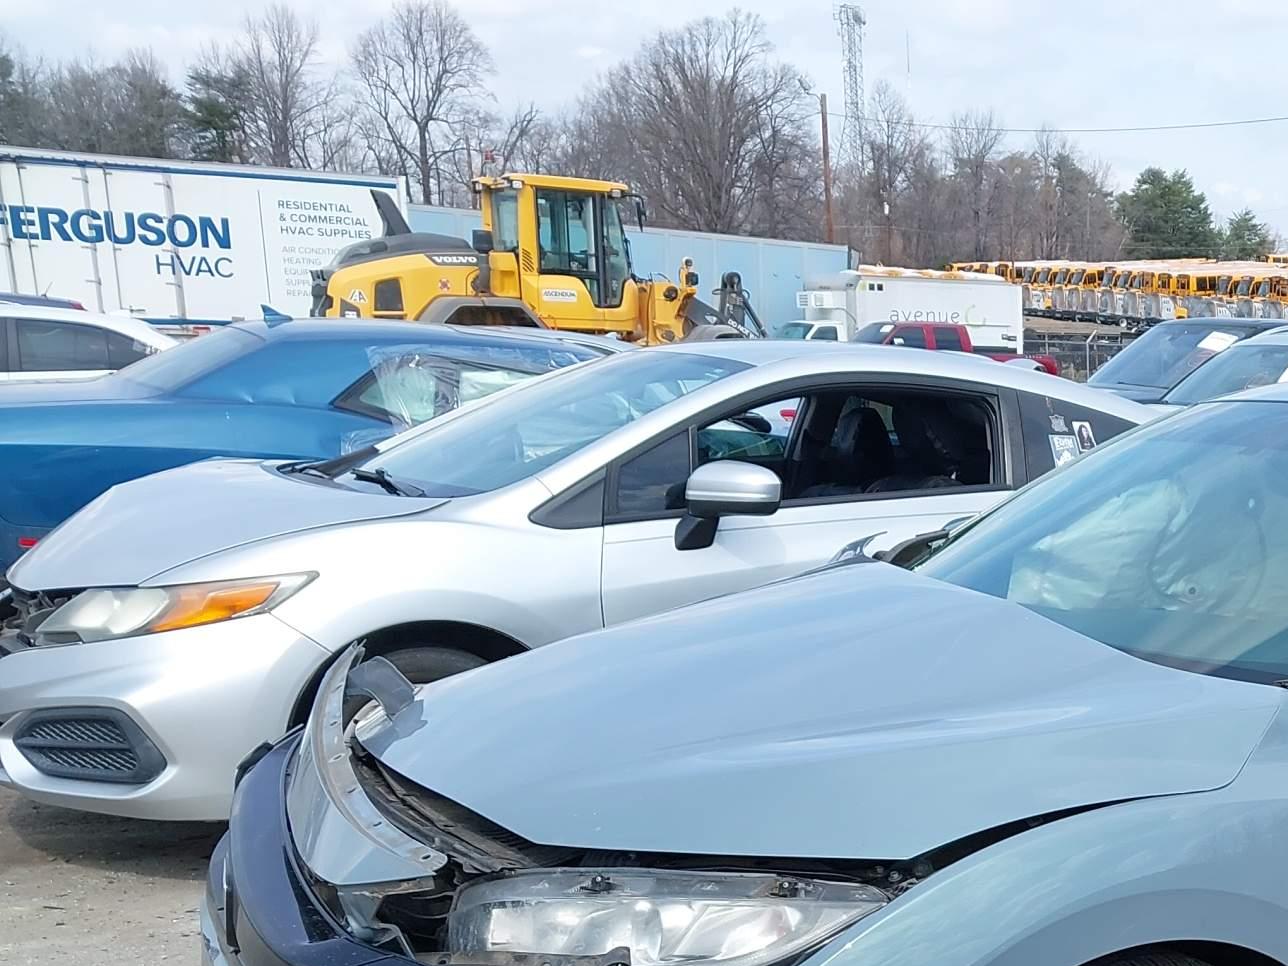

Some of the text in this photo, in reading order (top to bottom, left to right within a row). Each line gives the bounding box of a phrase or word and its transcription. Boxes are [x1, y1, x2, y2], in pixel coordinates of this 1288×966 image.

[277, 200, 353, 213] RESIDENTIAL
[279, 213, 369, 227] & COMMERCIAL
[280, 226, 372, 240] HVAC SUPPLIES
[282, 246, 296, 254] AIR
[155, 254, 234, 278] HVAC
[283, 256, 321, 265] HEATING
[890, 309, 960, 324] avenue
